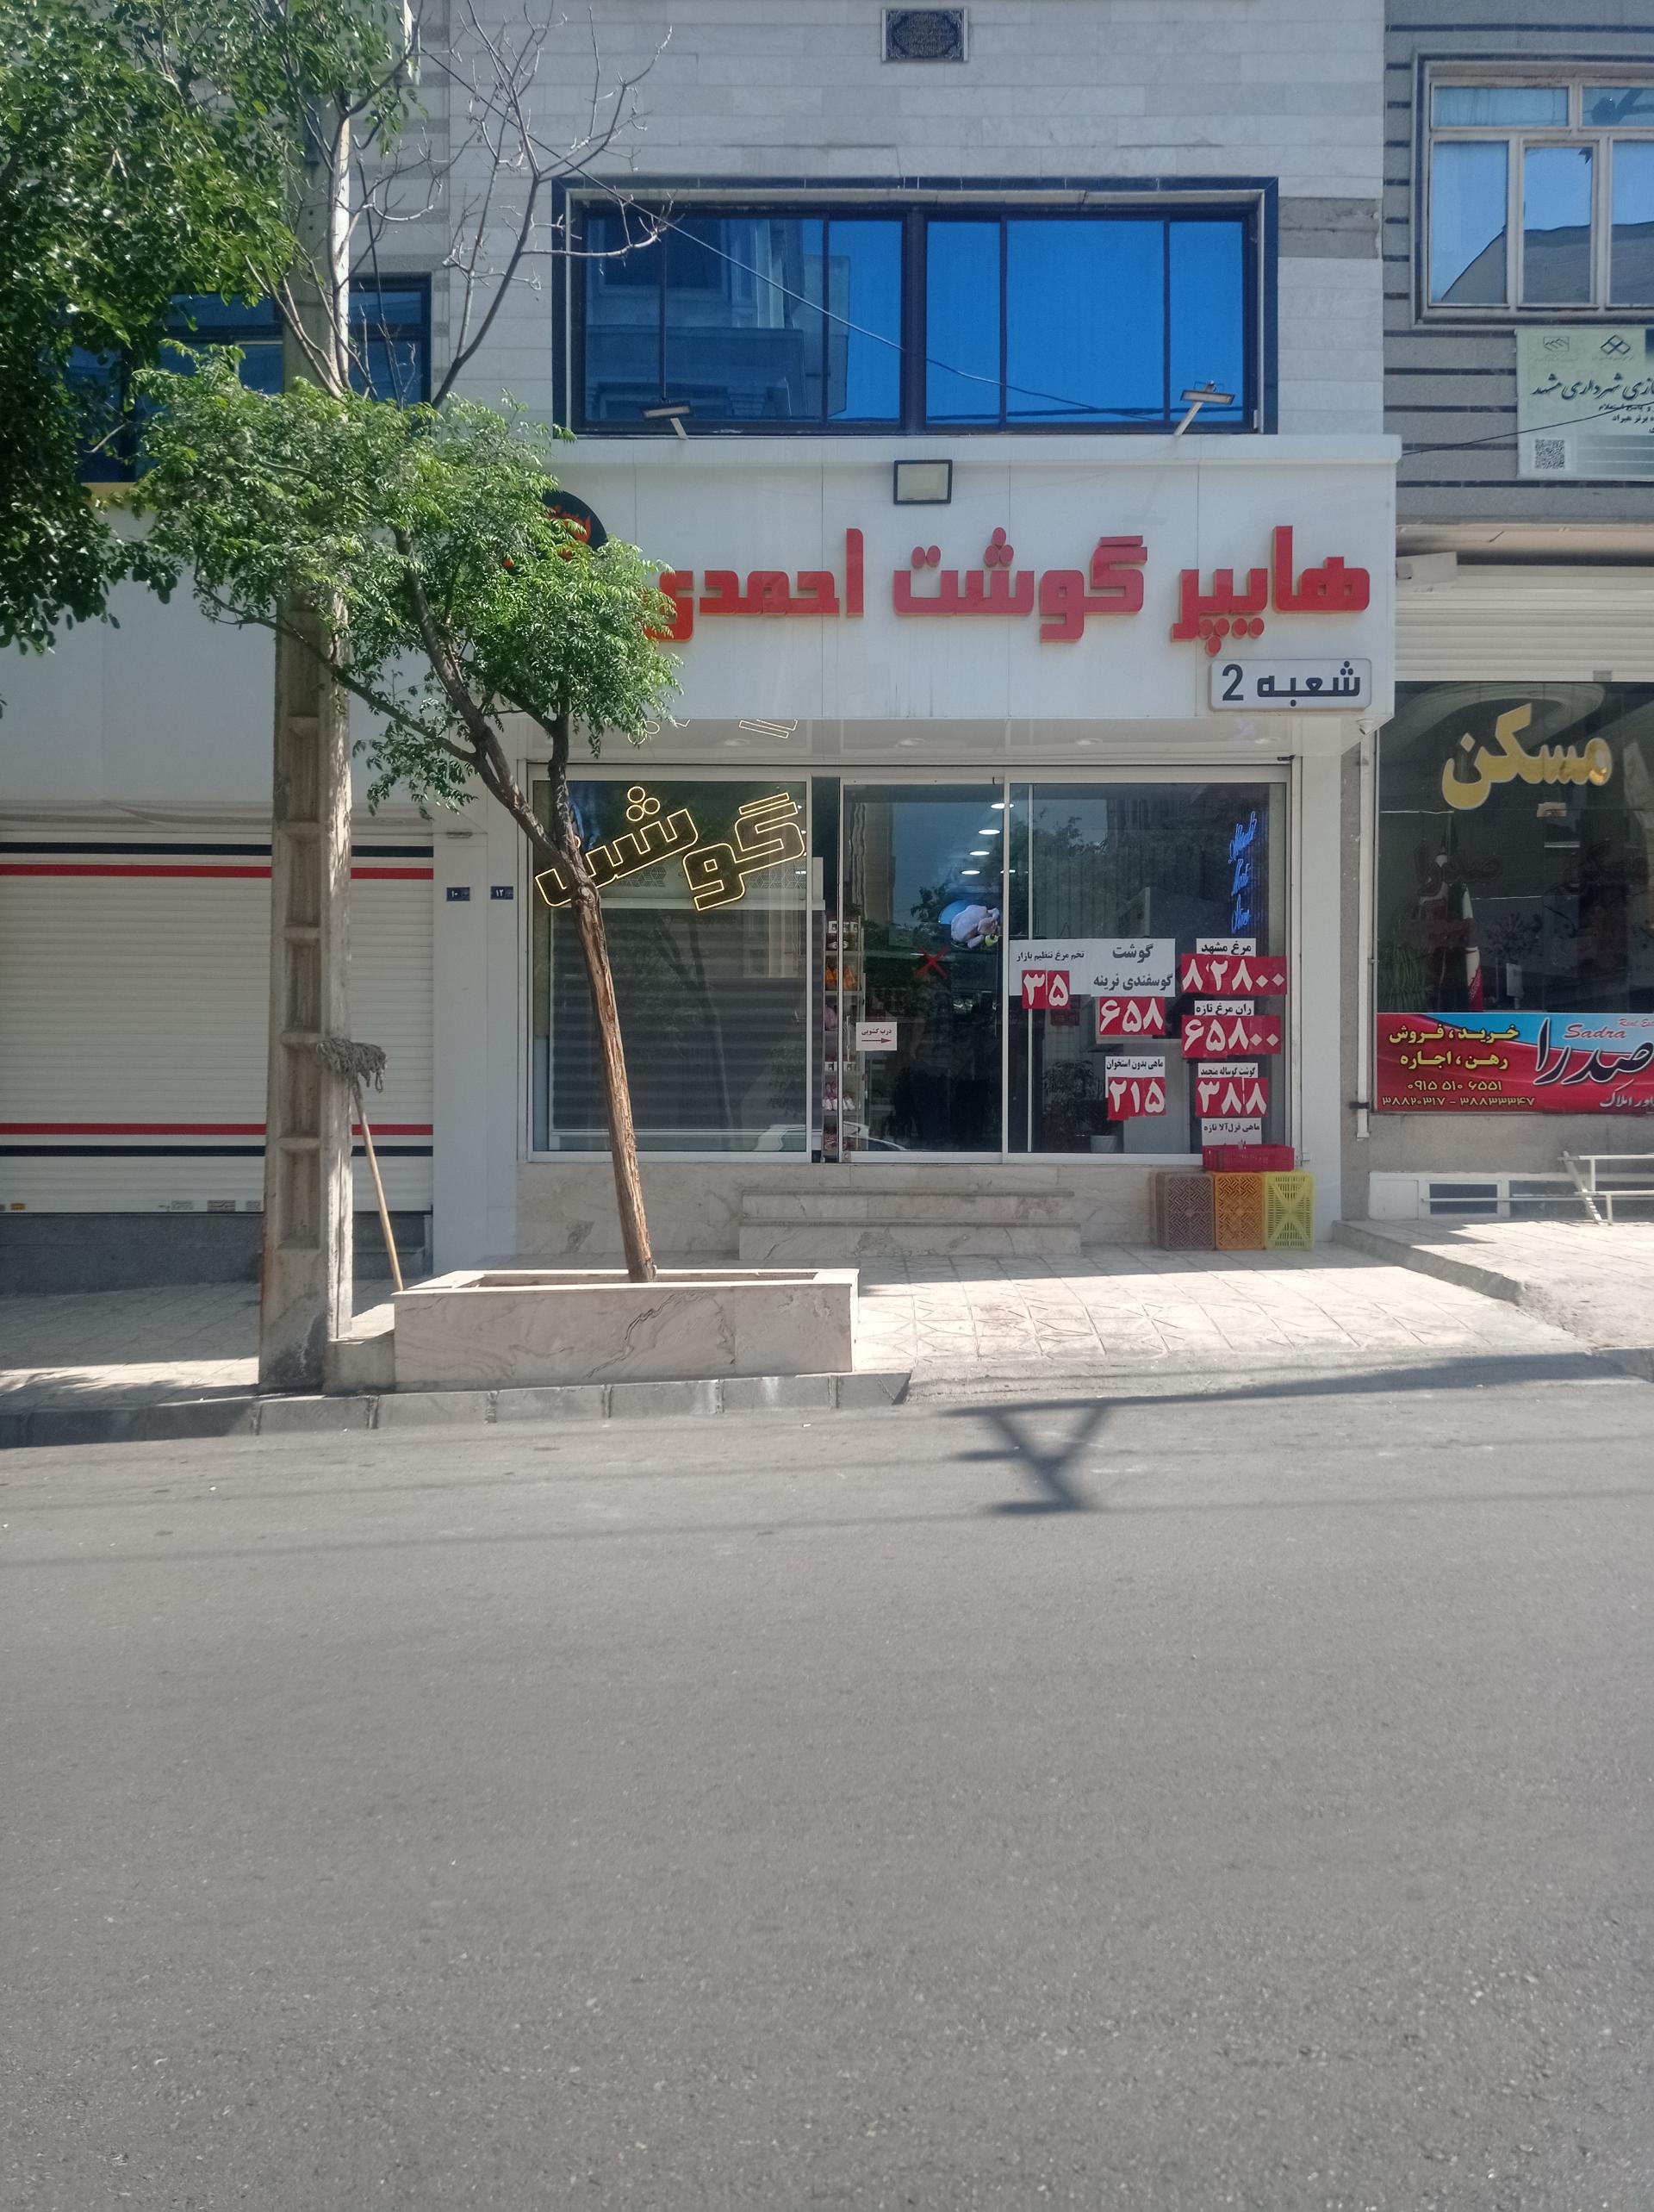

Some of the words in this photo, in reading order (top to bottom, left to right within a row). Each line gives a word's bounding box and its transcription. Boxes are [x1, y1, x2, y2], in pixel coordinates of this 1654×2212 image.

[1531, 373, 1563, 395] مشهد
[1562, 372, 1622, 400] شهرداری
[644, 527, 863, 643] احمدی
[893, 527, 1147, 643] گوشت
[1172, 526, 1371, 655] هایپر
[1222, 664, 1244, 701] 2
[1257, 661, 1360, 707] شعبه
[1442, 702, 1613, 810] مسکن
[1034, 950, 1053, 962] تنظیم
[1054, 951, 1069, 962] مرغ
[1071, 950, 1085, 961] تخم
[1112, 944, 1153, 963] گوشت
[1201, 942, 1228, 954] مشهد
[1231, 940, 1252, 955] مرغ
[1017, 952, 1032, 962] بازار
[1093, 973, 1120, 991] نرینه
[1122, 974, 1173, 991] گوسفندی
[1182, 958, 1285, 991] ۸۲۸۰۰
[1023, 973, 1069, 1006] ۳۵
[1100, 998, 1164, 1032] ۶۵۸
[1196, 1004, 1213, 1015] تازه
[1216, 1003, 1233, 1015] مرغ
[1235, 1004, 1252, 1015] ران
[1184, 1018, 1279, 1051] ۶۵۸۰۰
[1389, 1024, 1445, 1044] فروش
[1564, 1024, 1626, 1039] Sadra
[1400, 1050, 1452, 1069] اجاره
[1533, 1017, 1654, 1085] صدرا
[1106, 1059, 1130, 1069] استخوان
[1132, 1059, 1147, 1070] بدون
[1147, 1059, 1164, 1070] ماهی
[1219, 1067, 1238, 1078] گوساله
[1239, 1067, 1255, 1078] گوشت
[1408, 1080, 1438, 1091] ۰۹۱۵
[1442, 1080, 1463, 1091] ۵۱۰
[1468, 1080, 1502, 1091] ۶۵۵۱
[1600, 1078, 1635, 1107] املاک
[1109, 1080, 1165, 1113] ۲۱۵
[1197, 1081, 1267, 1115] ۳۸۸
[1203, 1124, 1216, 1132] تازه
[1242, 1123, 1260, 1132] ماهی
